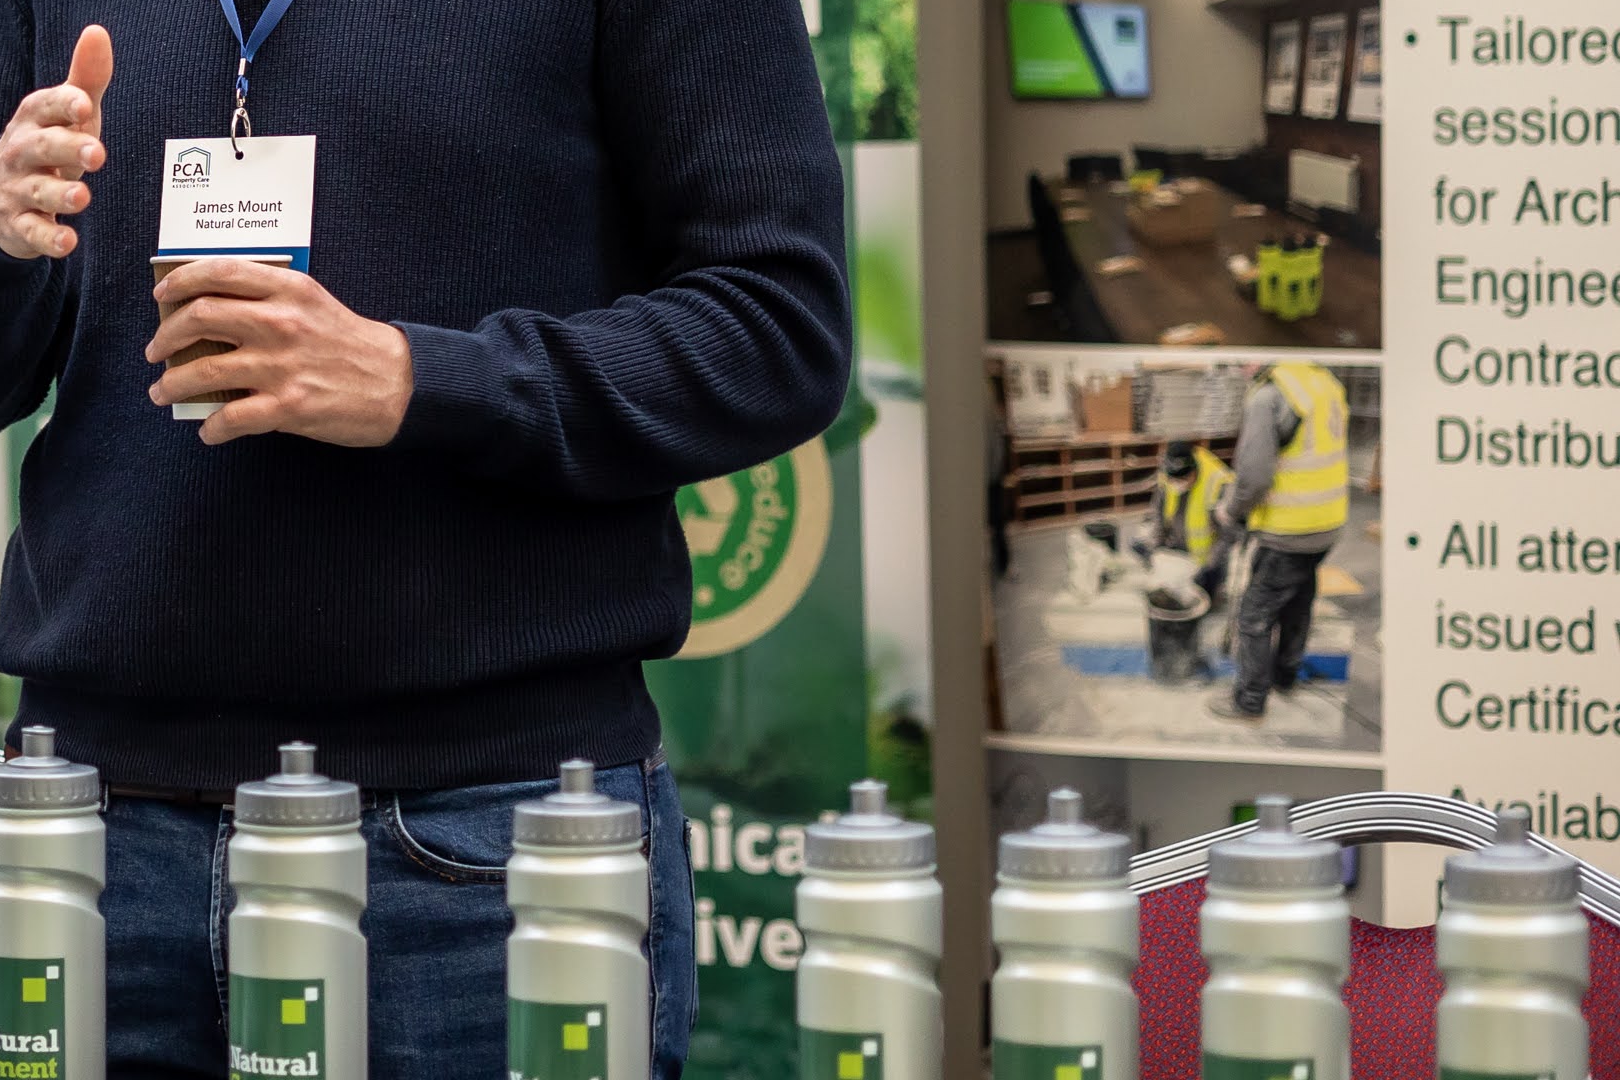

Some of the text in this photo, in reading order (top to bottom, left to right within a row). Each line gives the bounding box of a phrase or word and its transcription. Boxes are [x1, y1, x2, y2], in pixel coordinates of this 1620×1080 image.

[1434, 97, 1620, 146] session
[173, 163, 204, 176] PCA
[193, 200, 283, 214] James Mount
[196, 218, 278, 229] Natural Cement
[1434, 176, 1620, 226] for Arch
[1436, 416, 1620, 468] Distribu
[1439, 521, 1620, 574] All atte
[1435, 599, 1596, 654] issued
[1436, 679, 1620, 736] Certific
[231, 1045, 319, 1076] Natural
